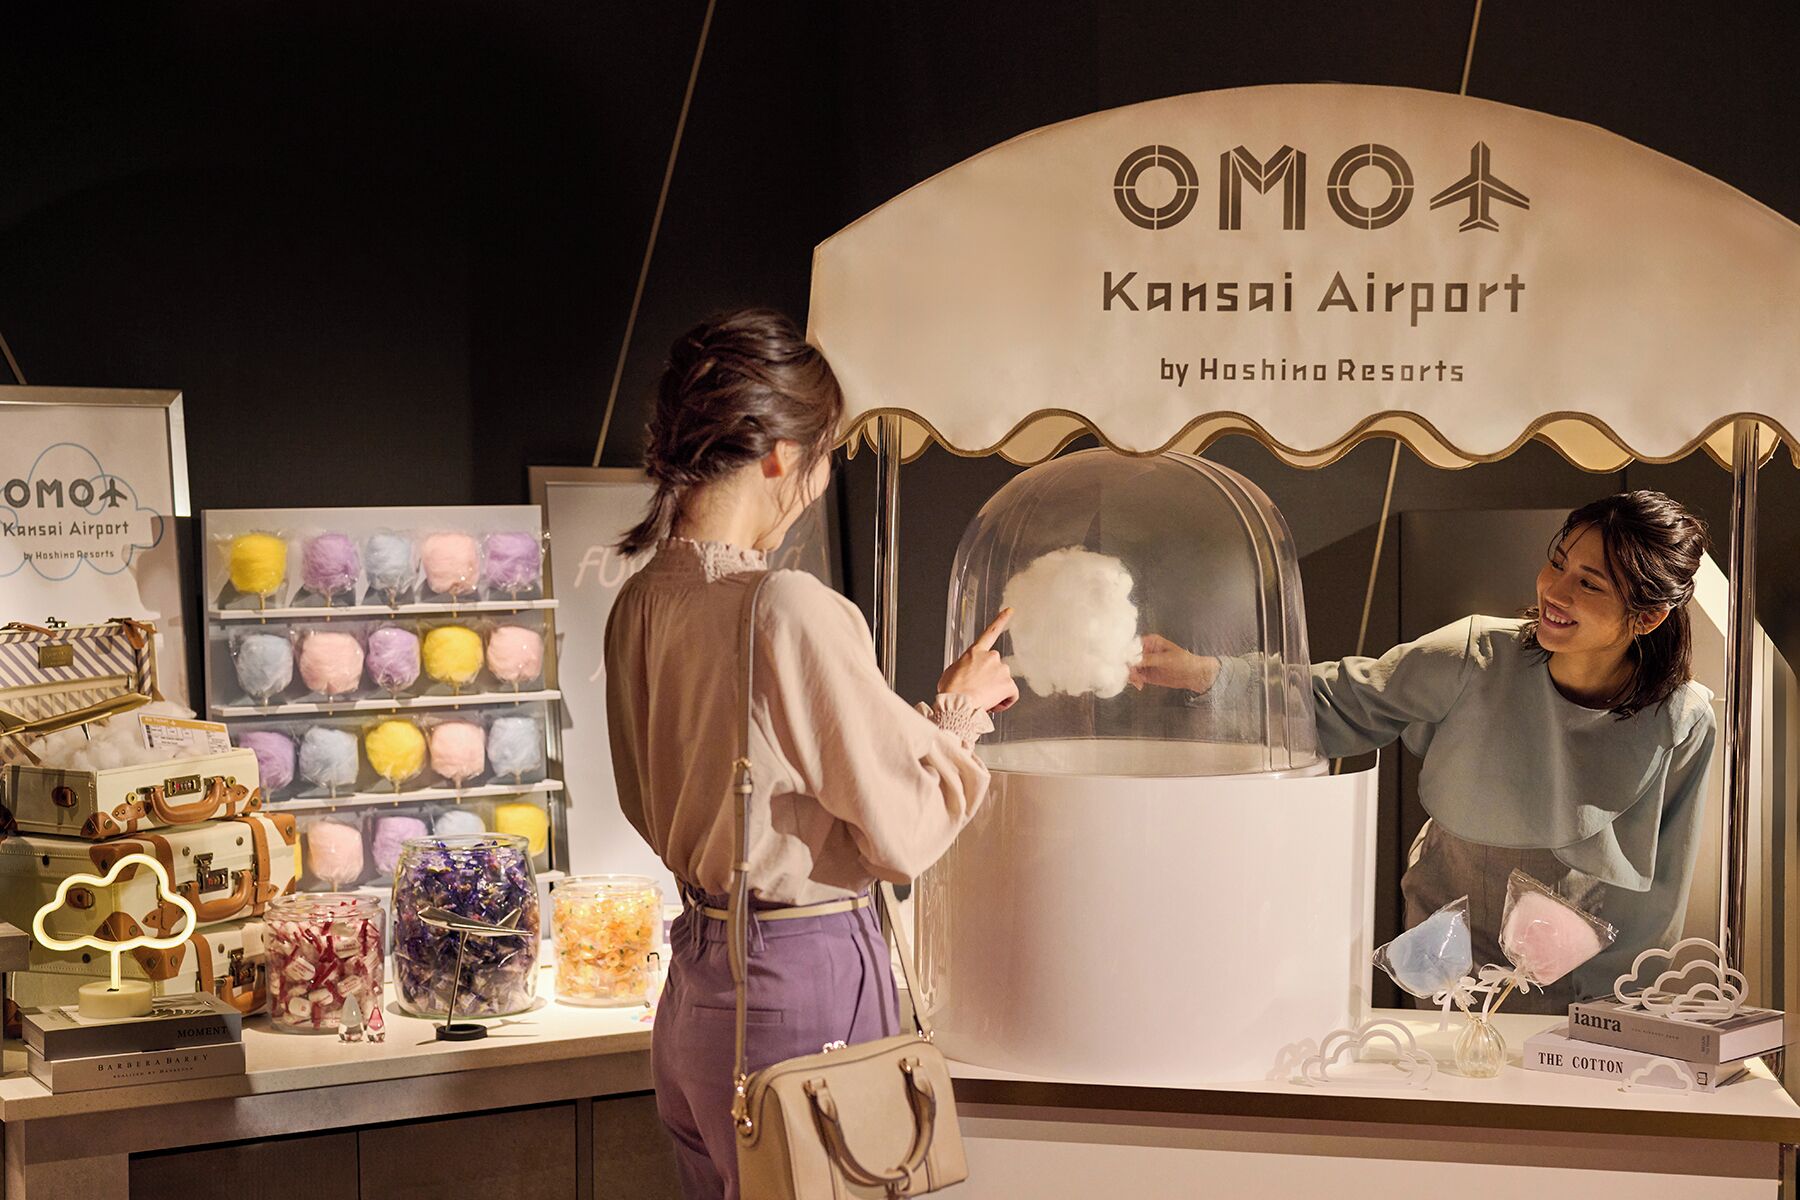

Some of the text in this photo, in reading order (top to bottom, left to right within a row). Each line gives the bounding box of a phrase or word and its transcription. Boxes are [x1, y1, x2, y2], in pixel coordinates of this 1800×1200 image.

[1114, 144, 1414, 230] OMO
[1104, 271, 1525, 326] Kansai Airport
[1161, 358, 1462, 387] by Hoshino Resorts
[4, 479, 94, 508] OMO
[3, 521, 129, 540] Kansai Airport
[23, 550, 114, 561] by Hoshino Resorts
[177, 1026, 228, 1038] MOMENT
[1573, 1006, 1622, 1033] ianra
[1538, 1051, 1623, 1074] THE COTTON
